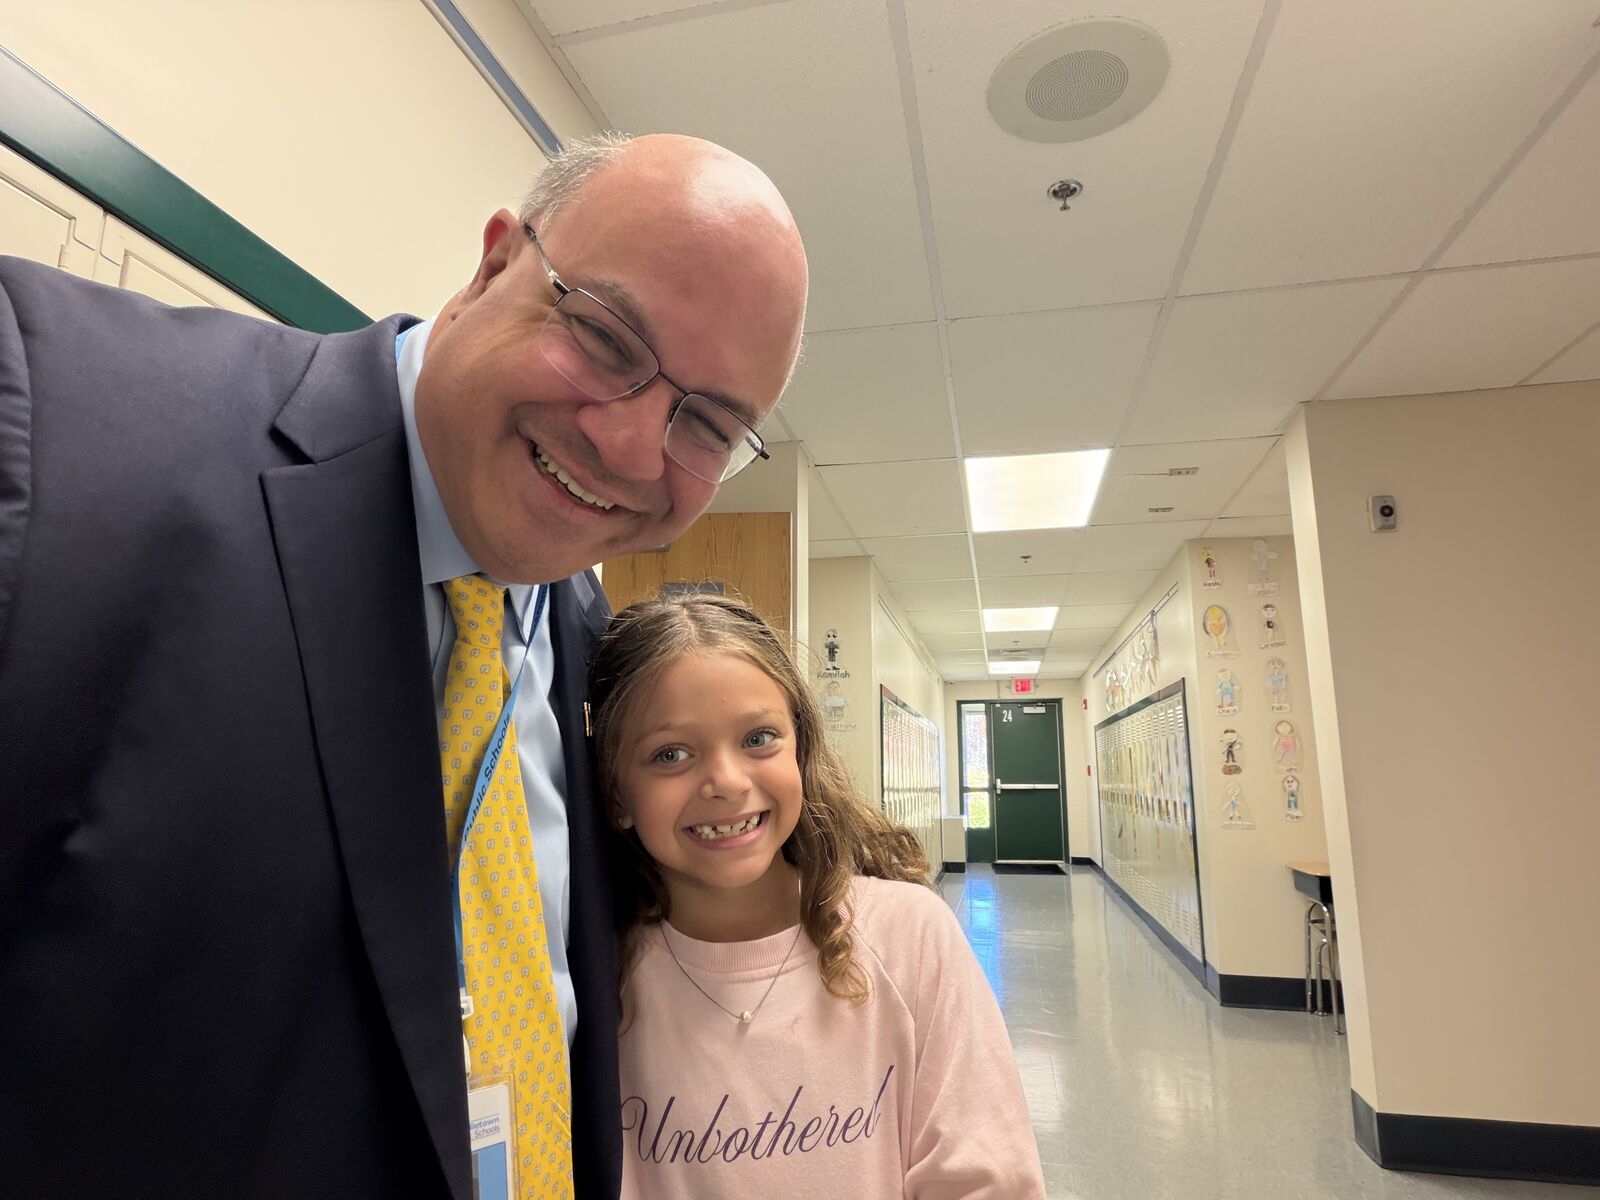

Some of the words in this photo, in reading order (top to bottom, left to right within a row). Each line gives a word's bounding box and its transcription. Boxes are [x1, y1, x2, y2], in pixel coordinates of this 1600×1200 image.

[1002, 709, 1013, 722] 24
[484, 713, 511, 781] Schools
[474, 1125, 501, 1138] Schools
[621, 1064, 895, 1164] Unbothered
